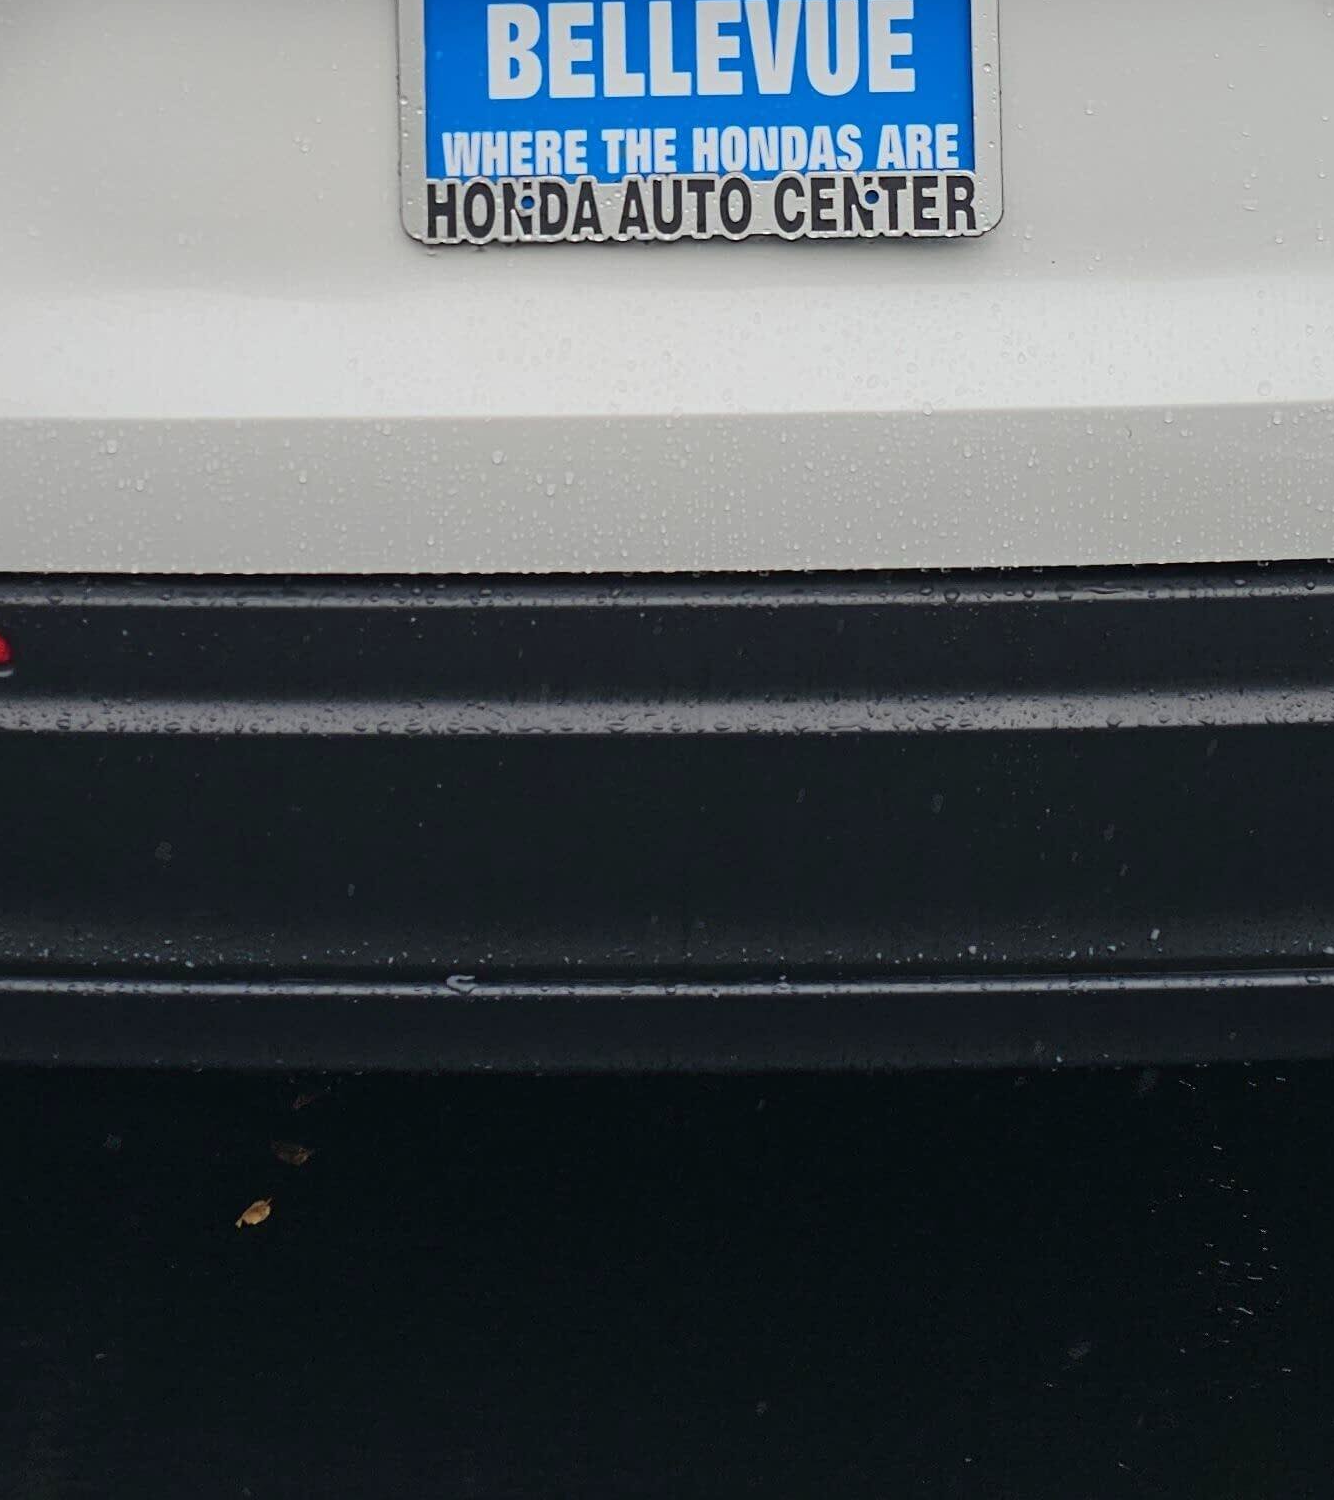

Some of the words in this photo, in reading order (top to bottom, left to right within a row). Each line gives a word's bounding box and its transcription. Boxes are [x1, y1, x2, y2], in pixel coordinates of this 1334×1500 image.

[441, 131, 588, 177] WHERE
[601, 128, 677, 174] THE
[691, 125, 864, 173] HONDAS
[876, 123, 960, 170] ARE
[426, 179, 603, 241] HONDA
[618, 176, 753, 237] AUTO
[775, 174, 977, 234] CENTER
